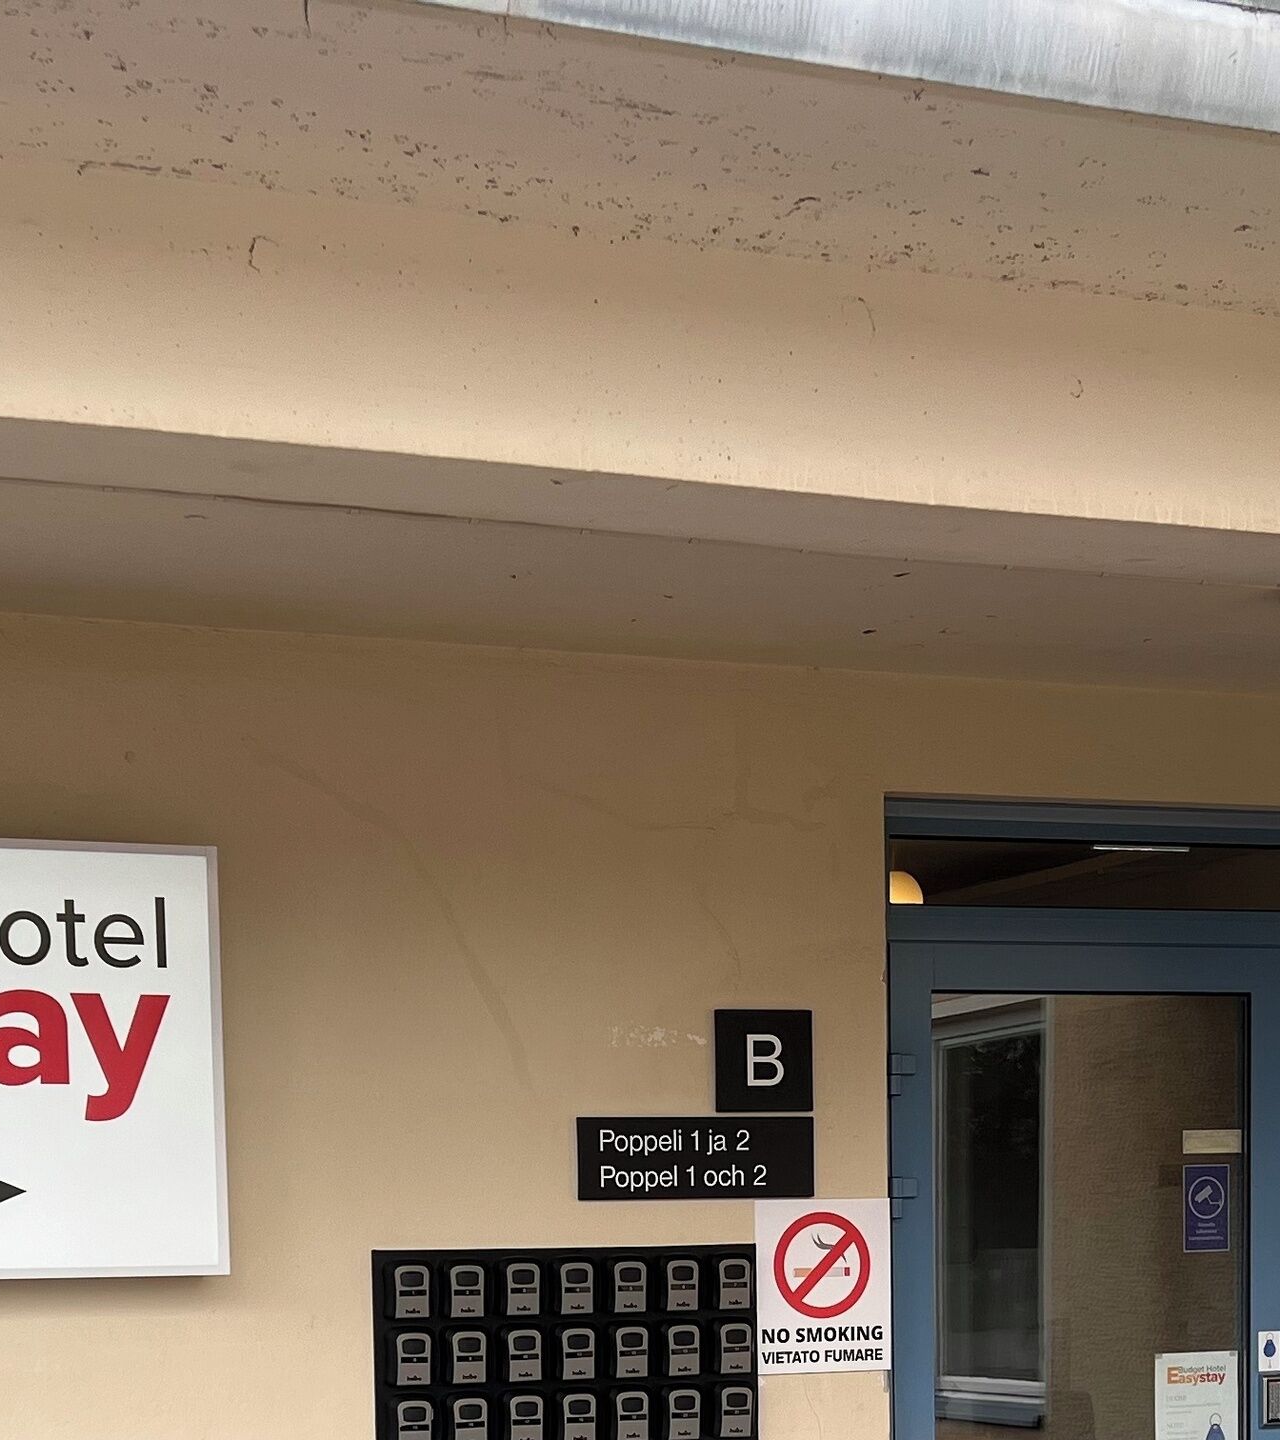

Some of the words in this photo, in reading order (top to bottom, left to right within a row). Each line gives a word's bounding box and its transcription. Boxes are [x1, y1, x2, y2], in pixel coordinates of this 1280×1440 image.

[745, 1033, 785, 1087] B
[599, 1129, 682, 1156] Poppeli
[690, 1130, 700, 1152] 1
[706, 1128, 727, 1155] ja
[735, 1129, 751, 1151] 2
[600, 1165, 678, 1192] Poppel
[685, 1165, 696, 1187] 1
[703, 1164, 745, 1187] och
[752, 1165, 768, 1186] 2
[761, 1328, 790, 1344] NO
[795, 1325, 884, 1343] SMOKING
[761, 1350, 820, 1365] VIETATO
[824, 1348, 884, 1362] FUMARE
[1167, 1366, 1226, 1386] Easystay
[1206, 1364, 1227, 1372] Hotel
